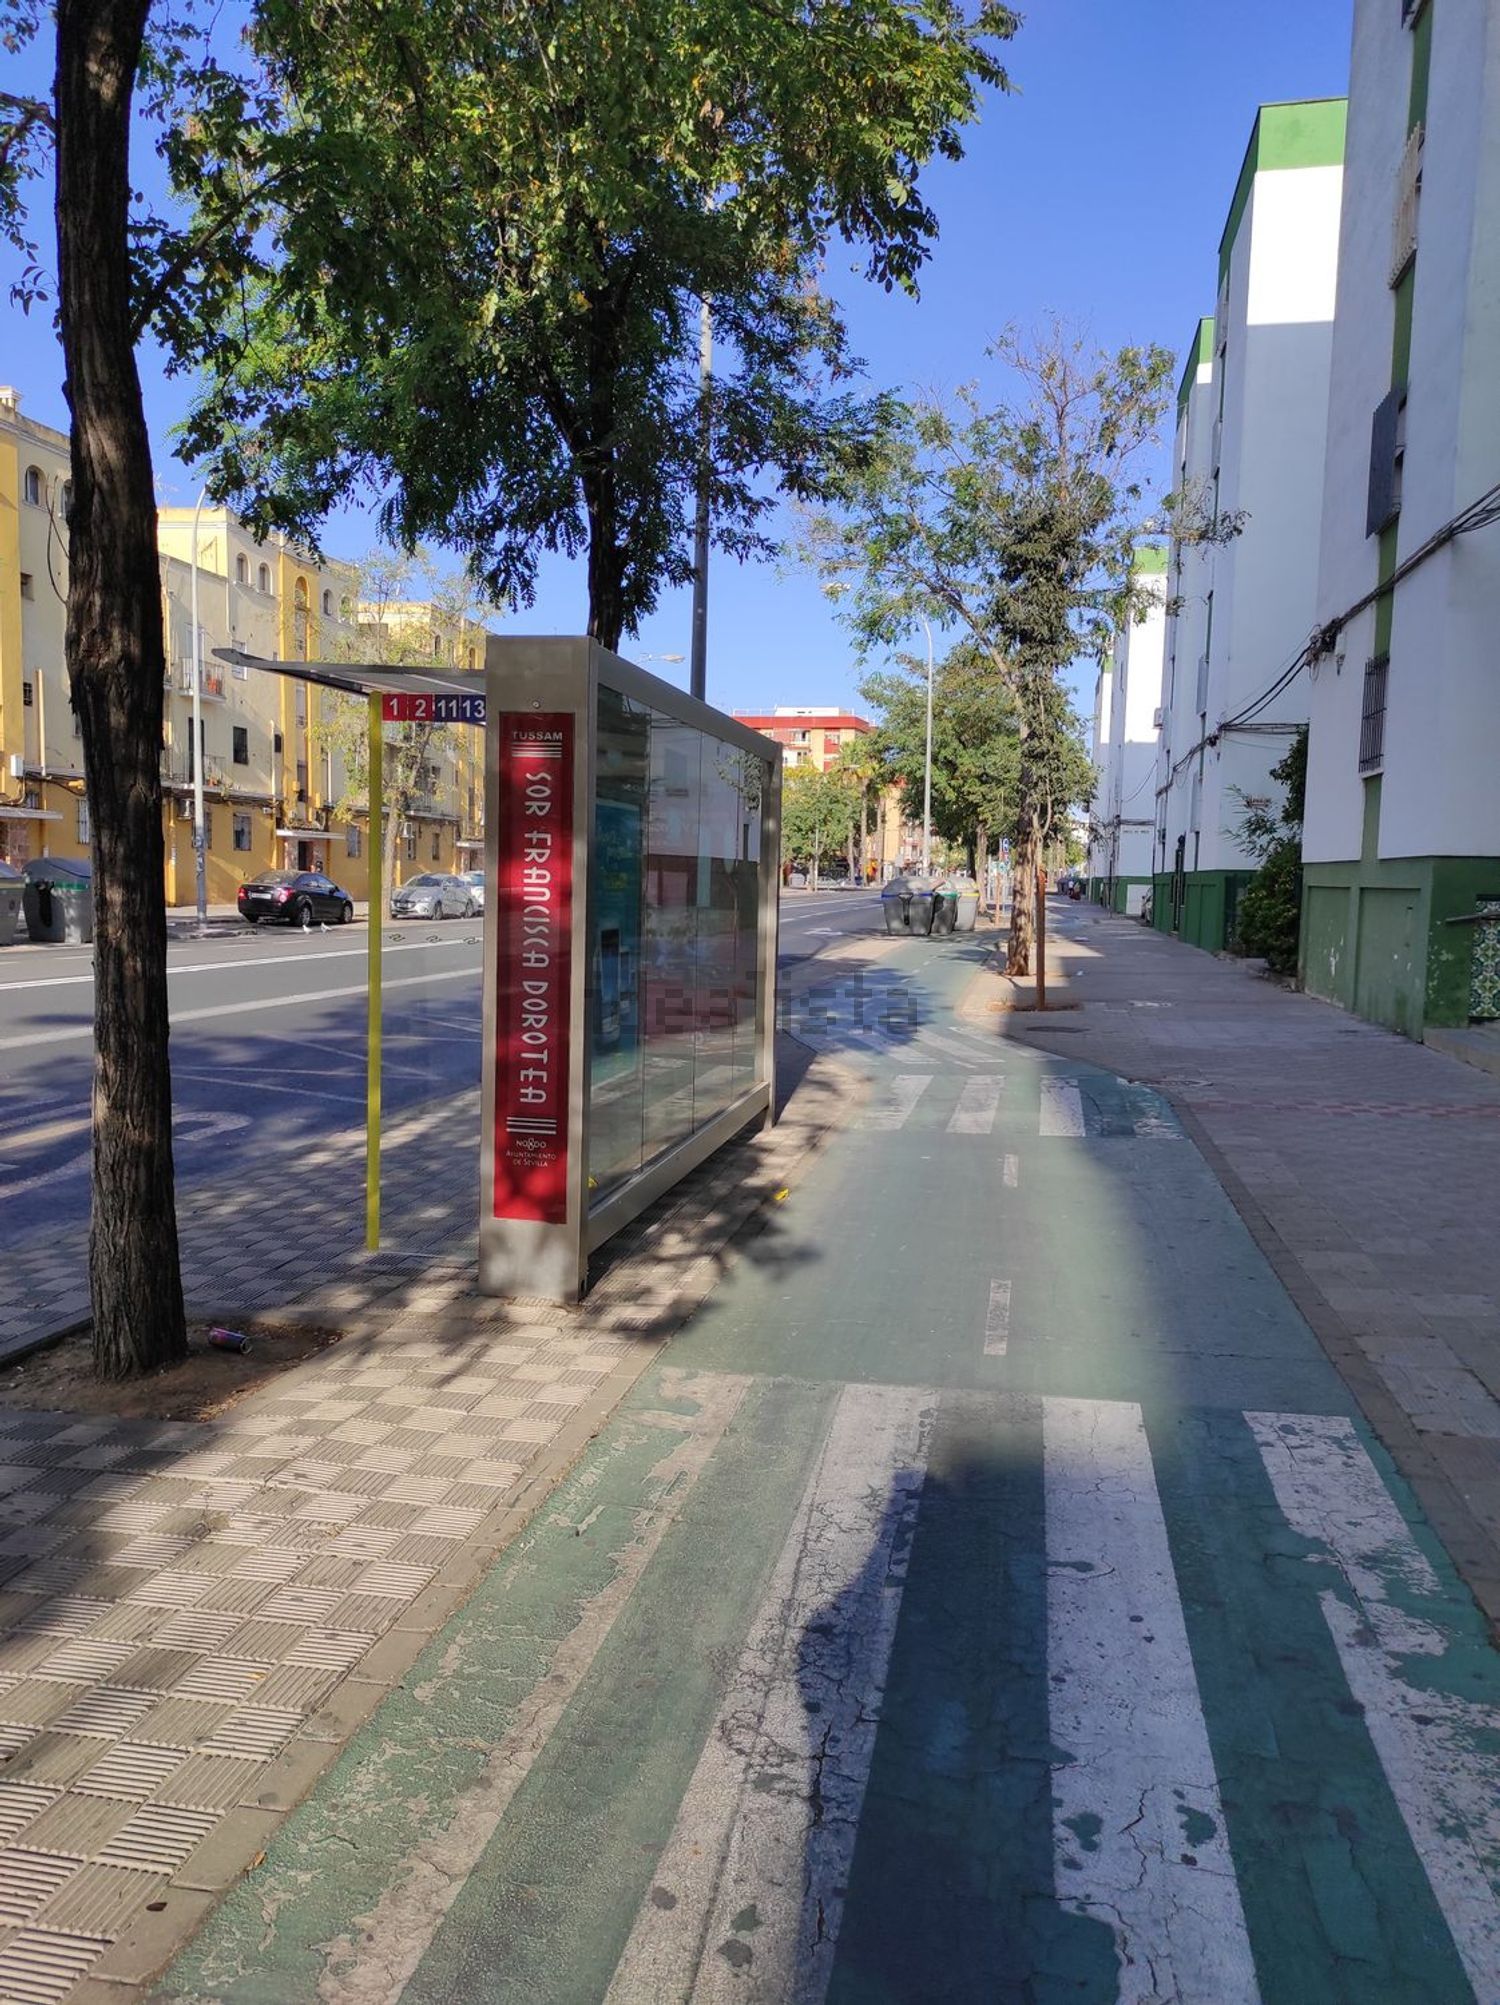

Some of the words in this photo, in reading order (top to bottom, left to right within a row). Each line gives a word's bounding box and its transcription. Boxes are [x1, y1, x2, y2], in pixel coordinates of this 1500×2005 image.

[389, 697, 399, 716] 1
[414, 699, 427, 717] 2
[437, 699, 458, 718] 11
[462, 699, 486, 718] 13
[512, 731, 563, 741] TUSSAM
[525, 772, 553, 816] SOR
[522, 831, 552, 968] FRANCISCA
[519, 980, 549, 1104] DOROTEA
